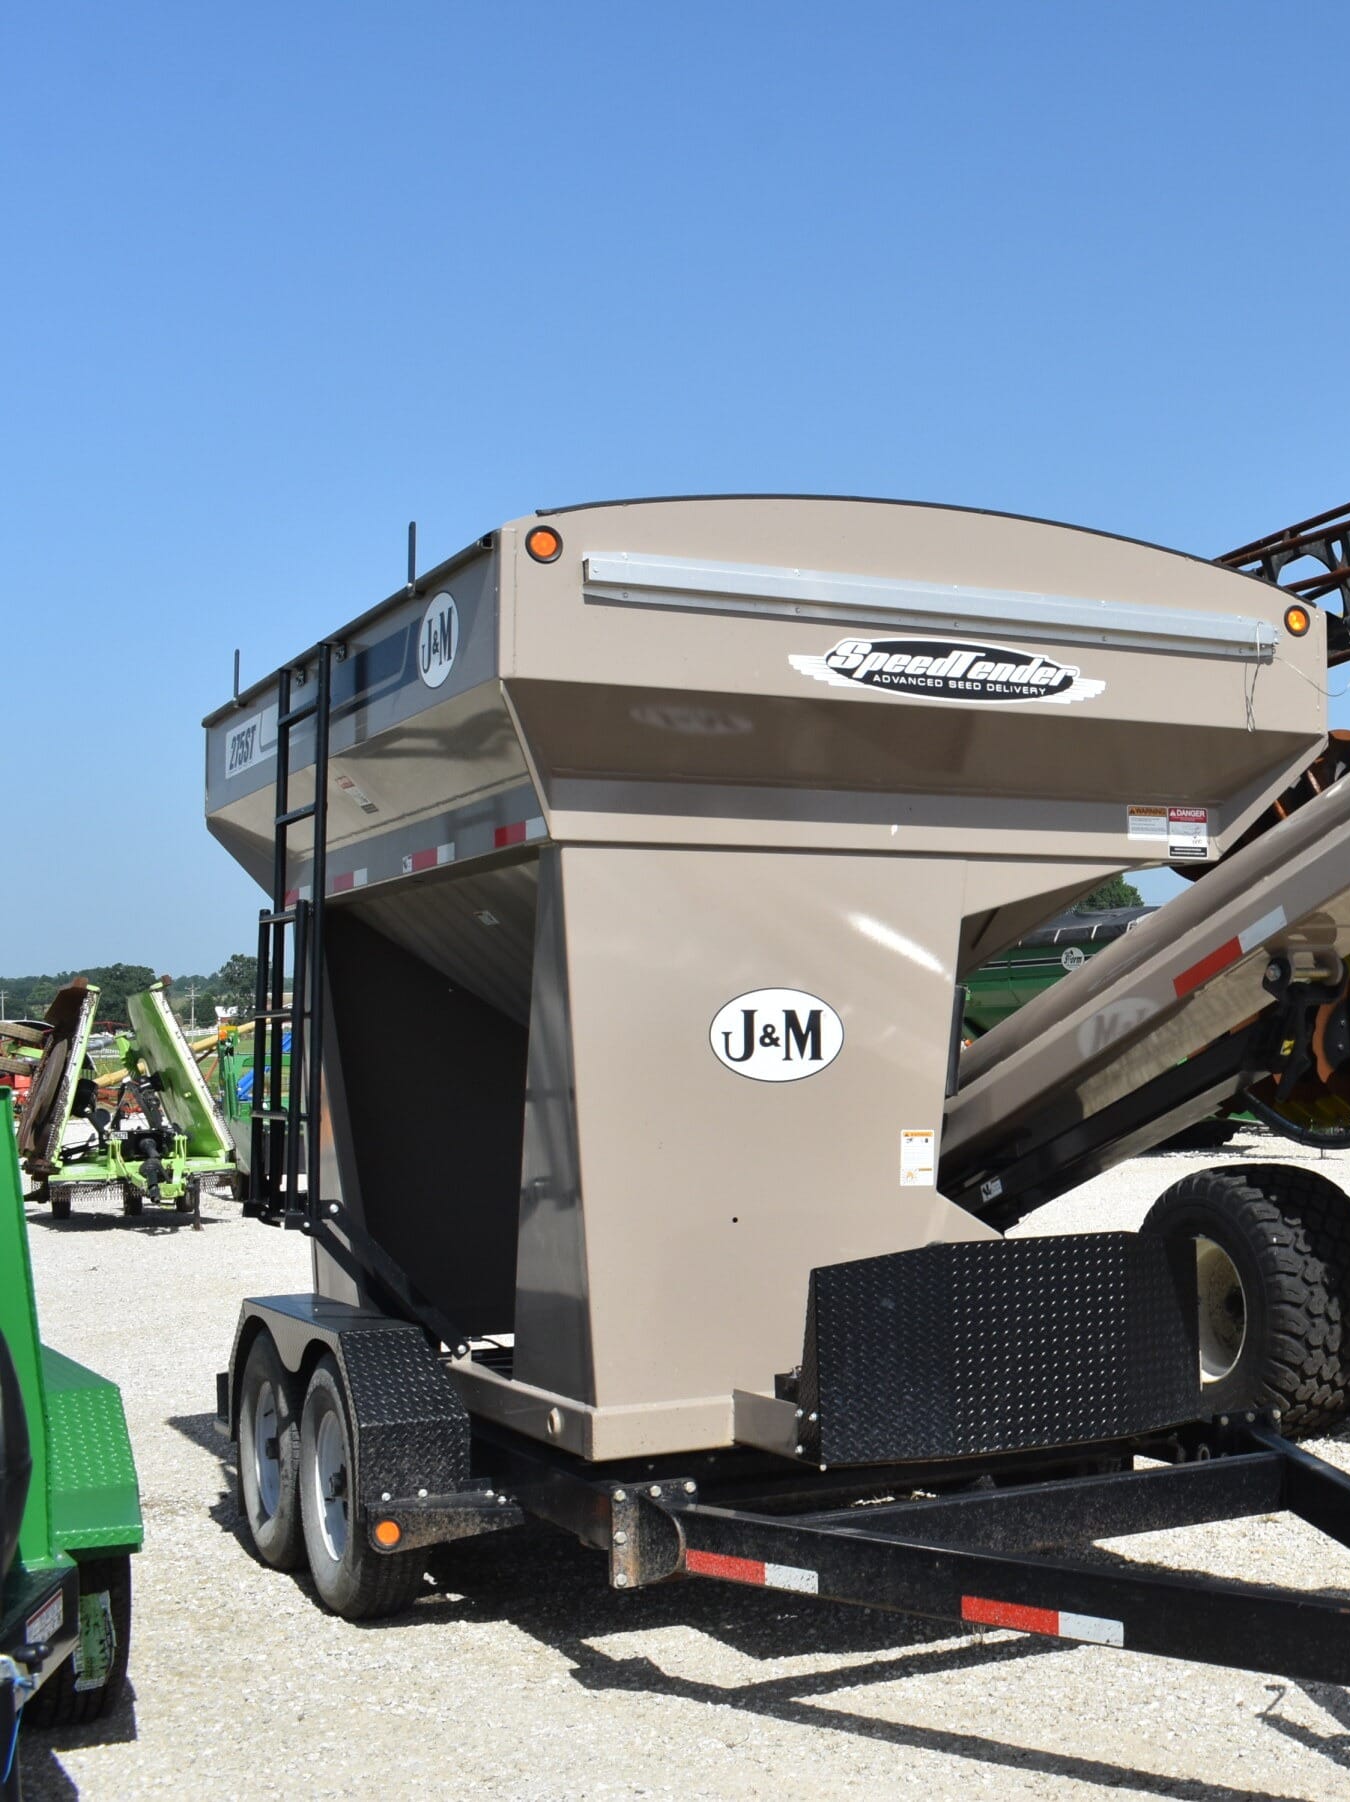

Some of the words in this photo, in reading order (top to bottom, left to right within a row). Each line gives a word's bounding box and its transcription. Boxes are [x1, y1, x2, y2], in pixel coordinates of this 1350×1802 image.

[421, 606, 453, 675] J&M
[872, 674, 944, 688] ADVANCED
[948, 680, 982, 691] SEED
[986, 683, 1047, 696] DELIVERY
[228, 723, 257, 772] 275ST
[1176, 808, 1206, 818] DANGER
[721, 1009, 824, 1063] J&M
